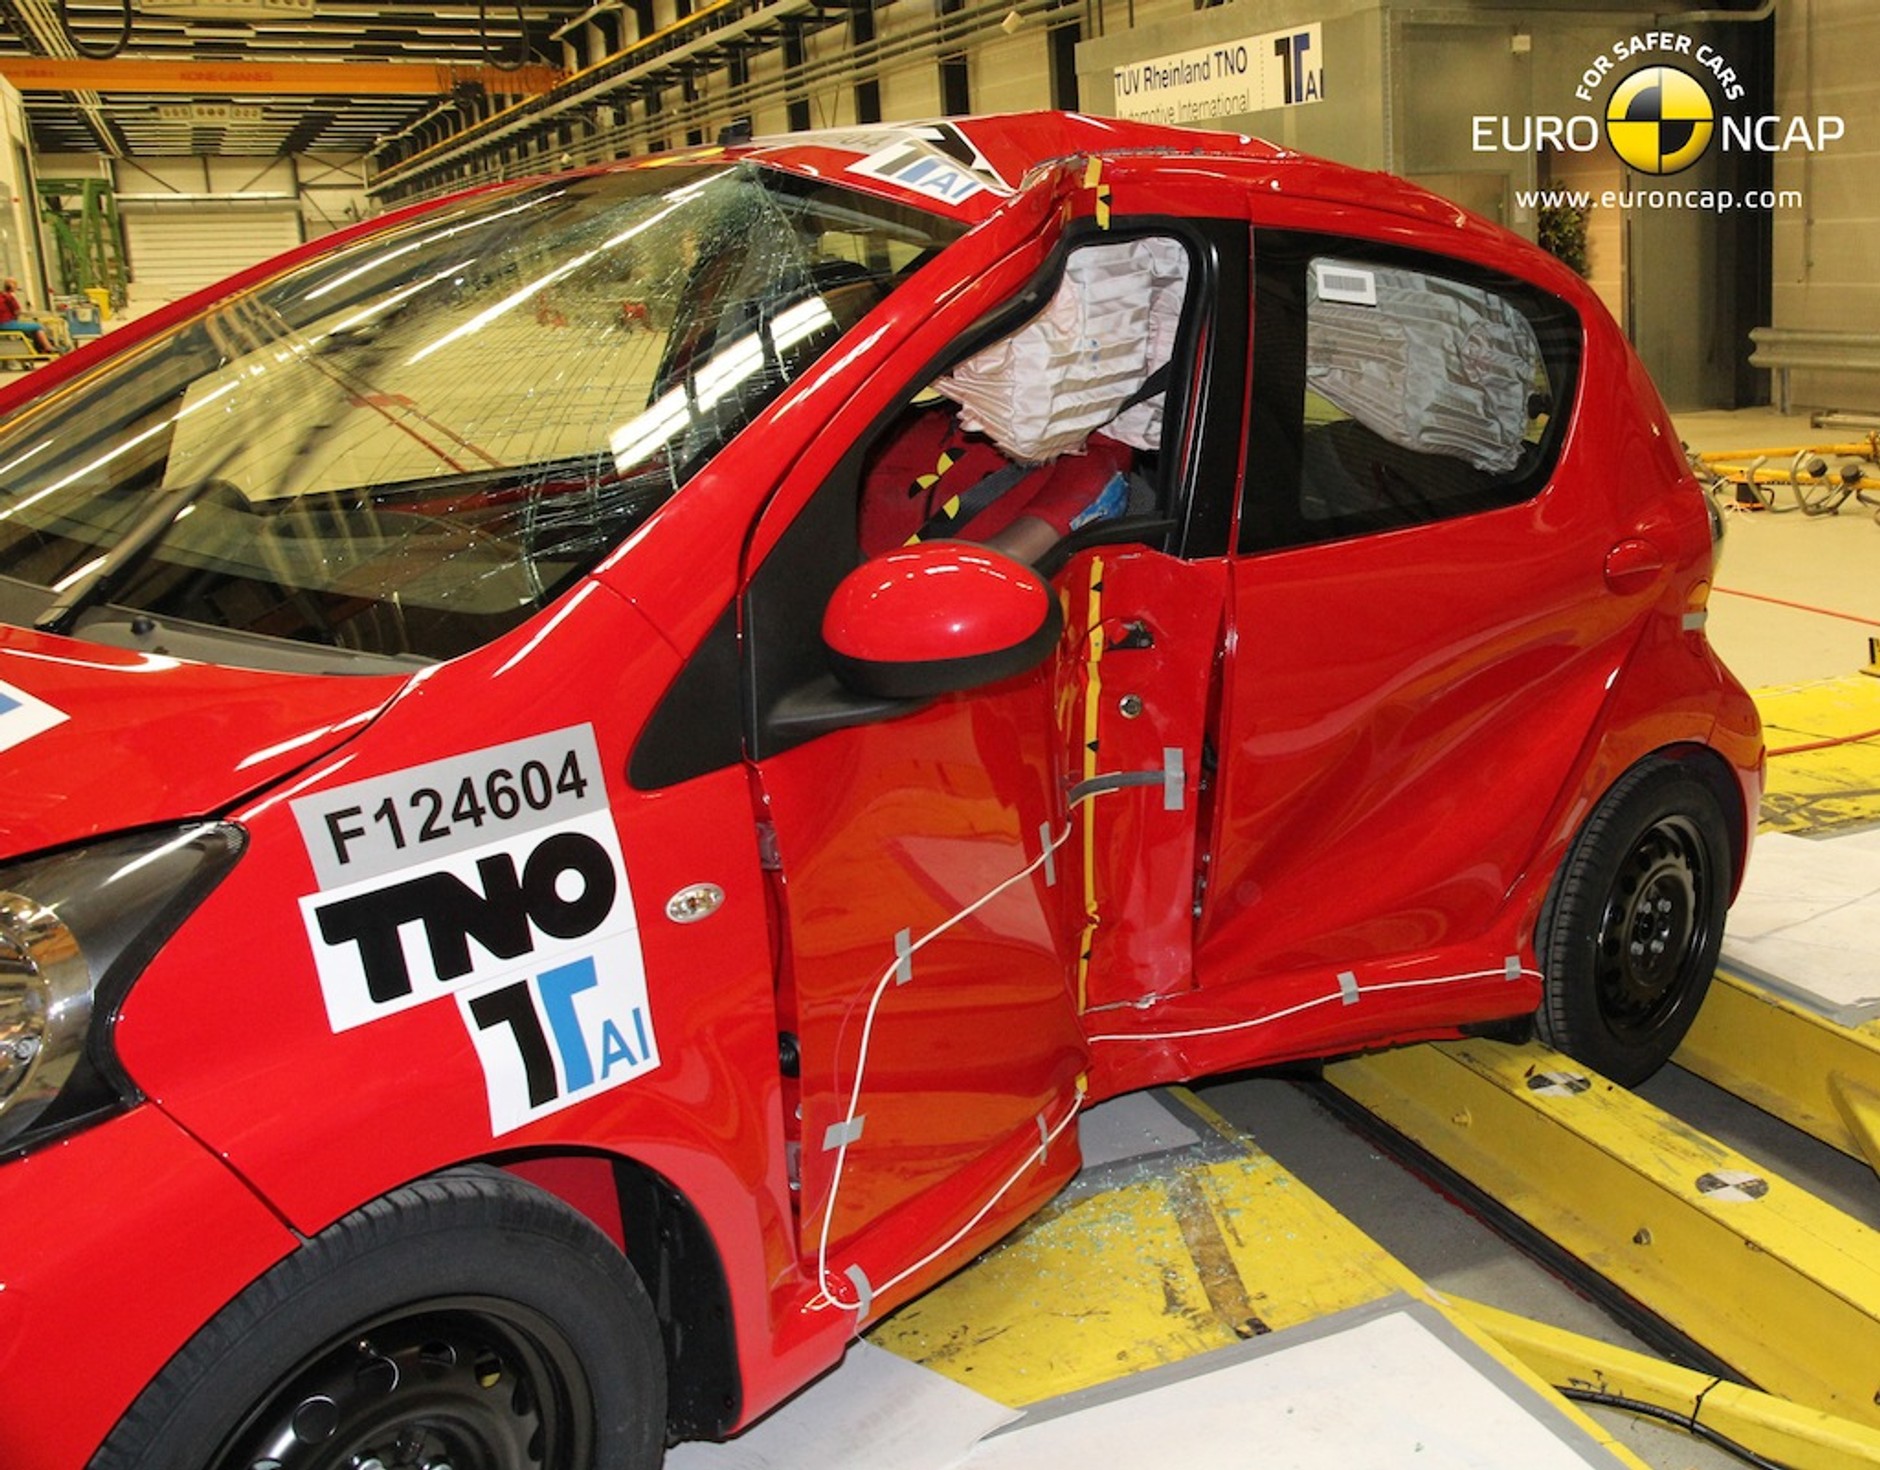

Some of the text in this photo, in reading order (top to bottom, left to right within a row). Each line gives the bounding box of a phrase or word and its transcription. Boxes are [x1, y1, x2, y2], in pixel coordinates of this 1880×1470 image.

[1115, 46, 1248, 96] TÜV Rheinland TNO
[1178, 87, 1250, 122] International
[324, 750, 588, 864] F124604
[315, 832, 616, 1003] TNO
